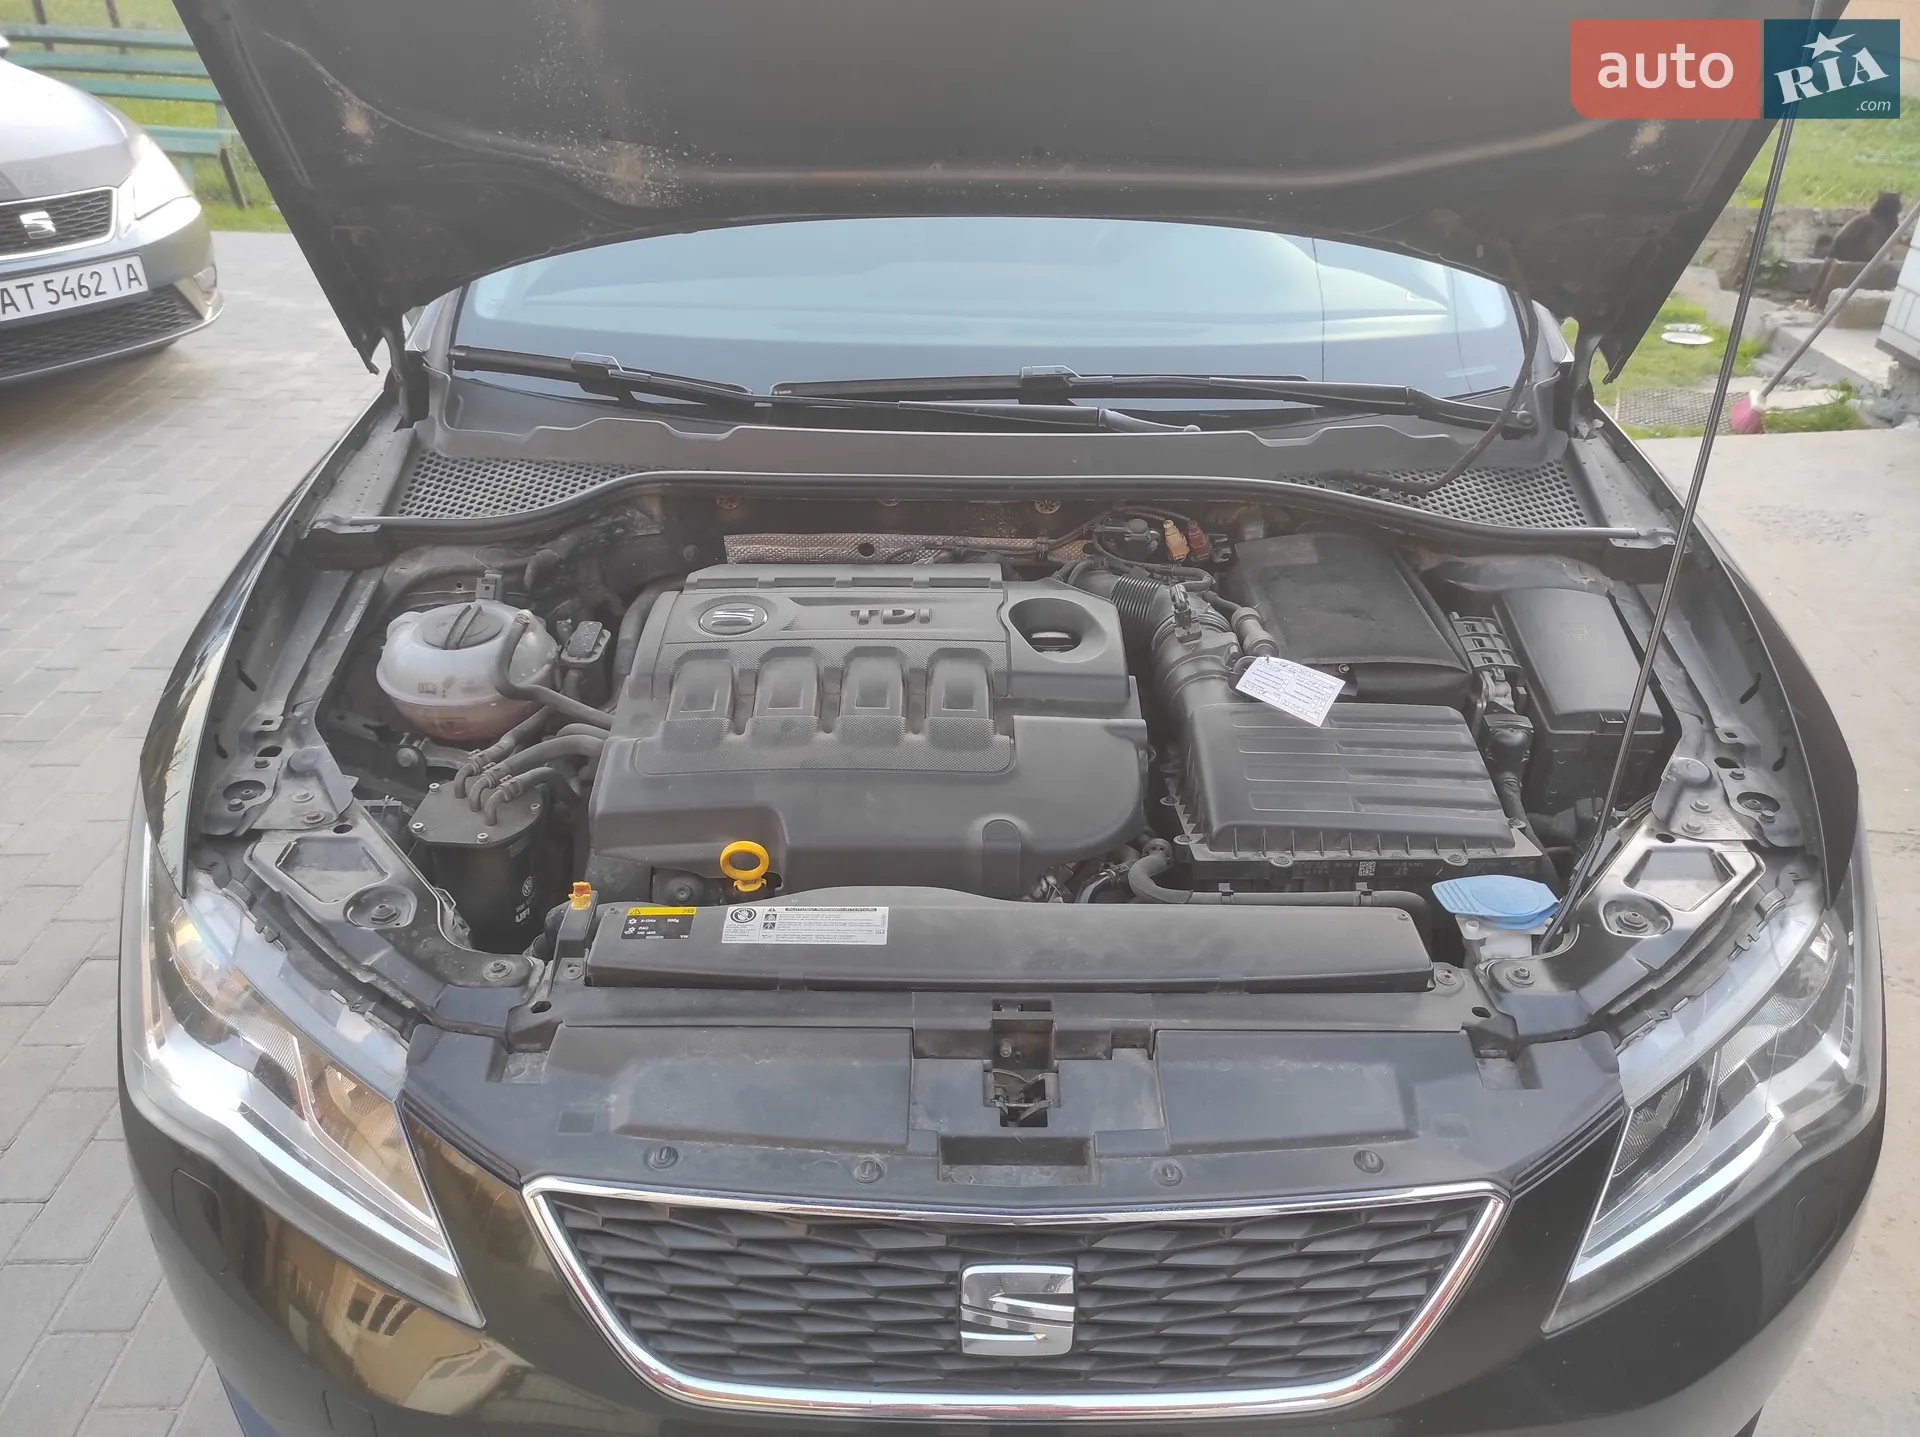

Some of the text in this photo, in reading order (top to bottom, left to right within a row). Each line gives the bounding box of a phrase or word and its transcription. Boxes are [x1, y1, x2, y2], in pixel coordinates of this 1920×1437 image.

[0, 263, 143, 315] AT 5462 IA
[849, 608, 932, 626] TDI
